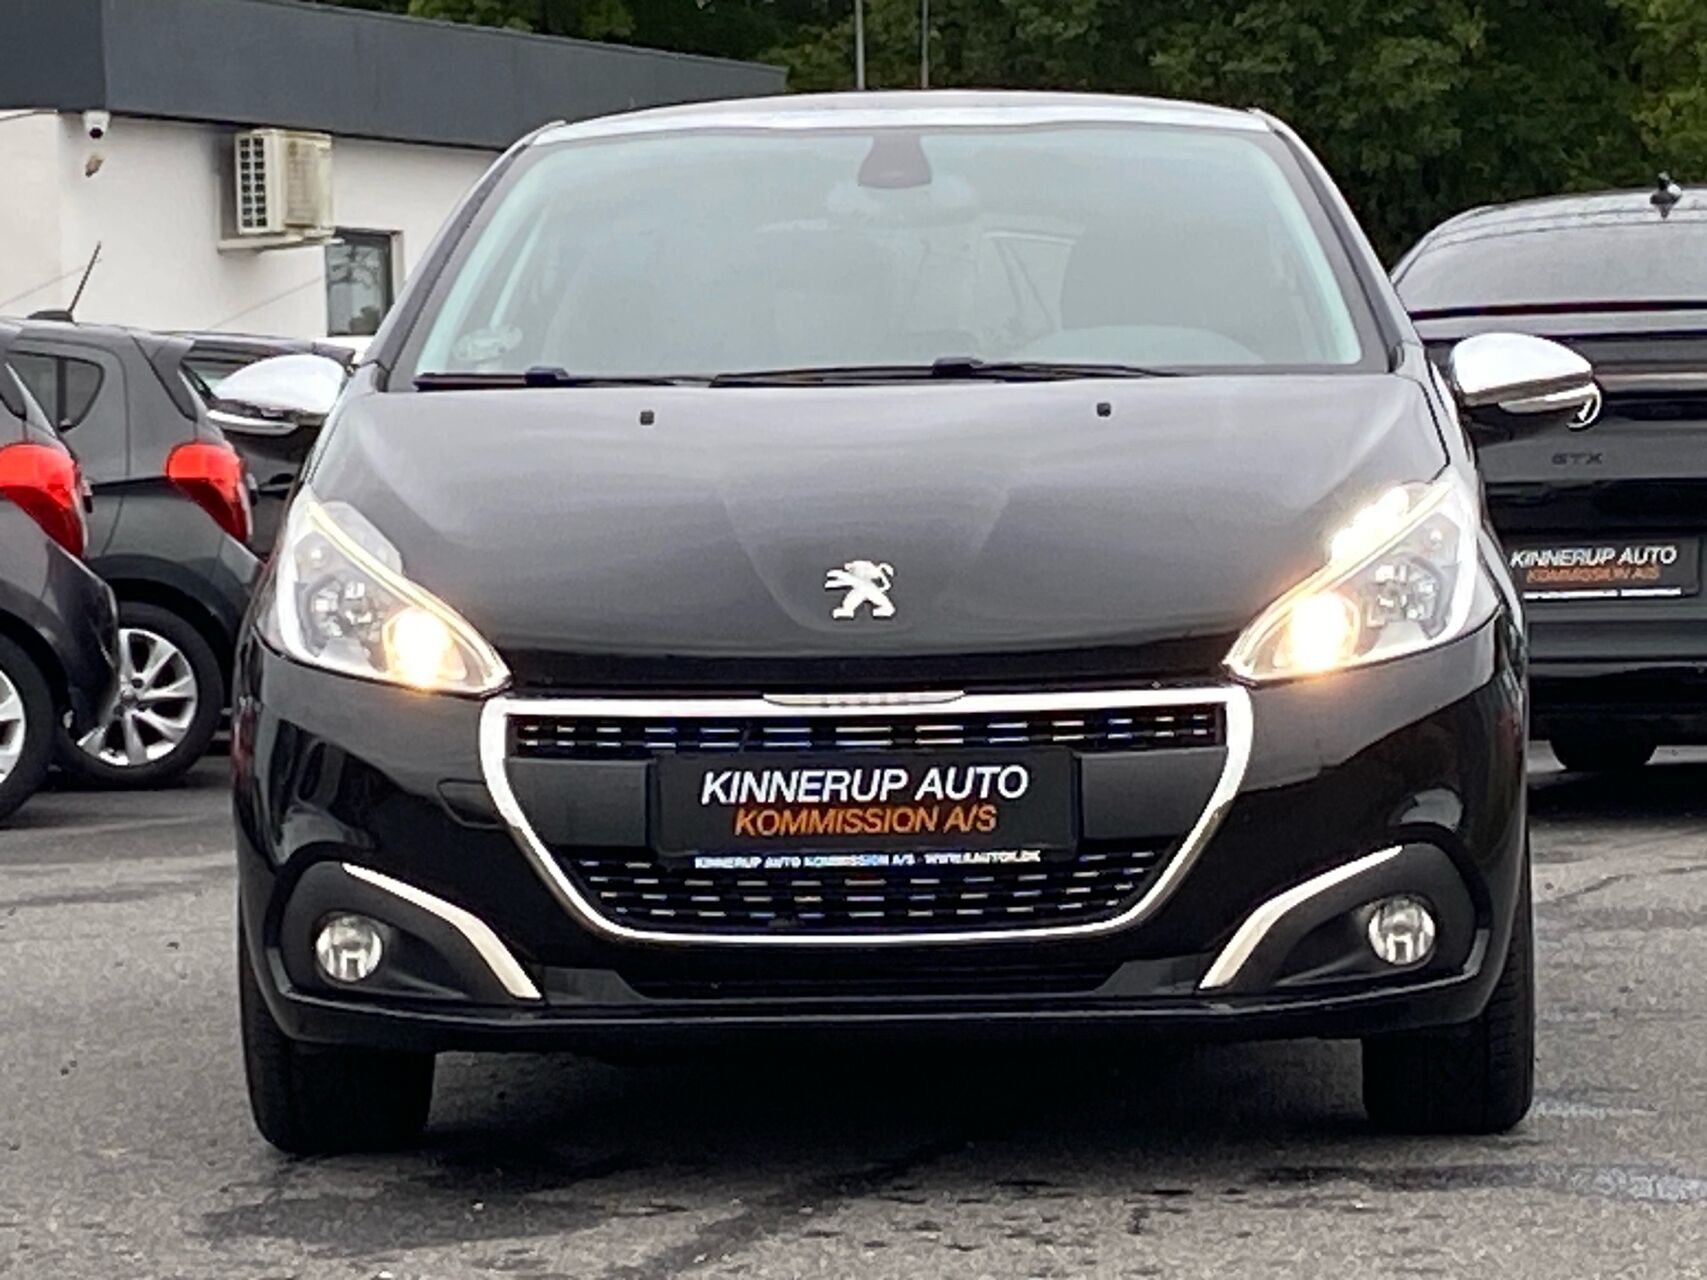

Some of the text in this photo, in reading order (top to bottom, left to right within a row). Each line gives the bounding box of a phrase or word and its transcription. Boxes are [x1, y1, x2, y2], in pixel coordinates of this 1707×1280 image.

[1551, 452, 1602, 465] GTX
[1510, 546, 1677, 568] KINNERUP AUTO
[701, 766, 1029, 805] KINNERUP AUTO
[735, 805, 997, 836] KOMMISSION A/S
[695, 856, 762, 869] KINNERUP
[764, 856, 801, 868] AUTO
